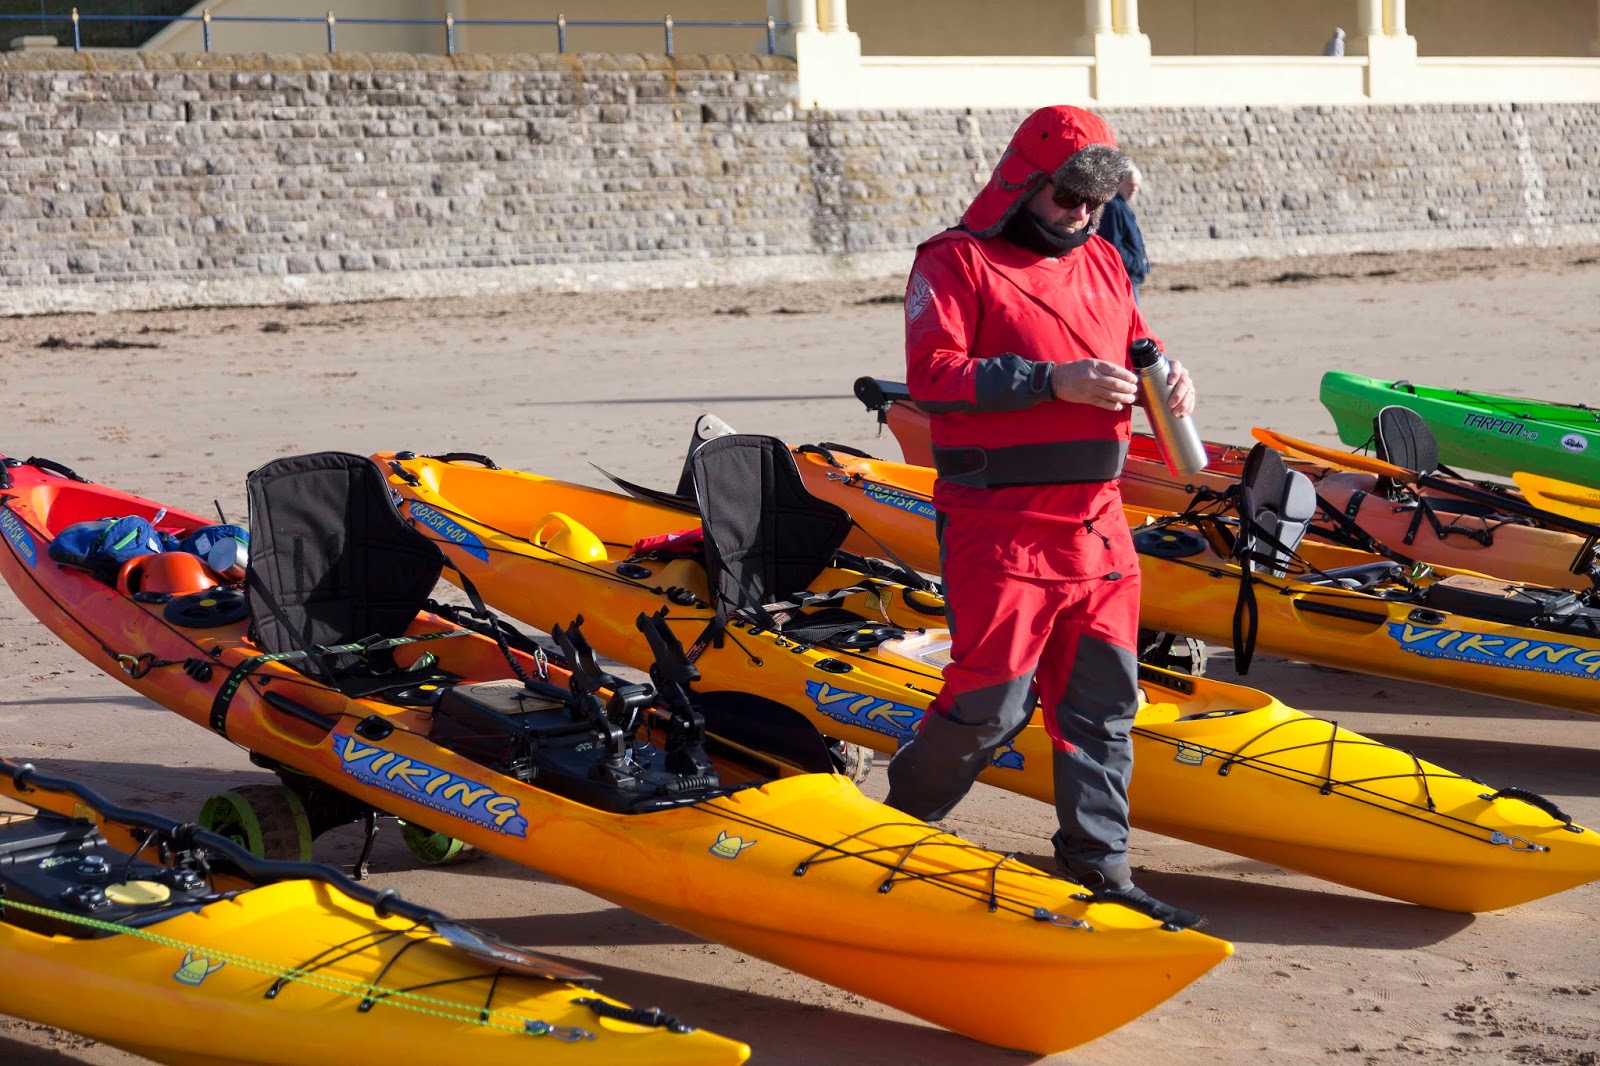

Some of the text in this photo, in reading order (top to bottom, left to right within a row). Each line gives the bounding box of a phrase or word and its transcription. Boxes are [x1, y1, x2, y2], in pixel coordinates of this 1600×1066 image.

[1463, 412, 1525, 437] TARPON
[409, 501, 468, 543] PROFISH 400
[1401, 624, 1600, 674] VIKING
[1407, 647, 1435, 656] MADE
[1481, 659, 1531, 670] ZEALAND
[1534, 666, 1561, 675] WITH
[1564, 671, 1599, 680] PRIDE
[822, 709, 848, 722] MADE
[851, 718, 861, 726] IN
[865, 723, 887, 734] NEW
[343, 737, 518, 826] VIKING
[346, 768, 506, 835] MADE IN NEW ZEALAND WITH PRIDE
